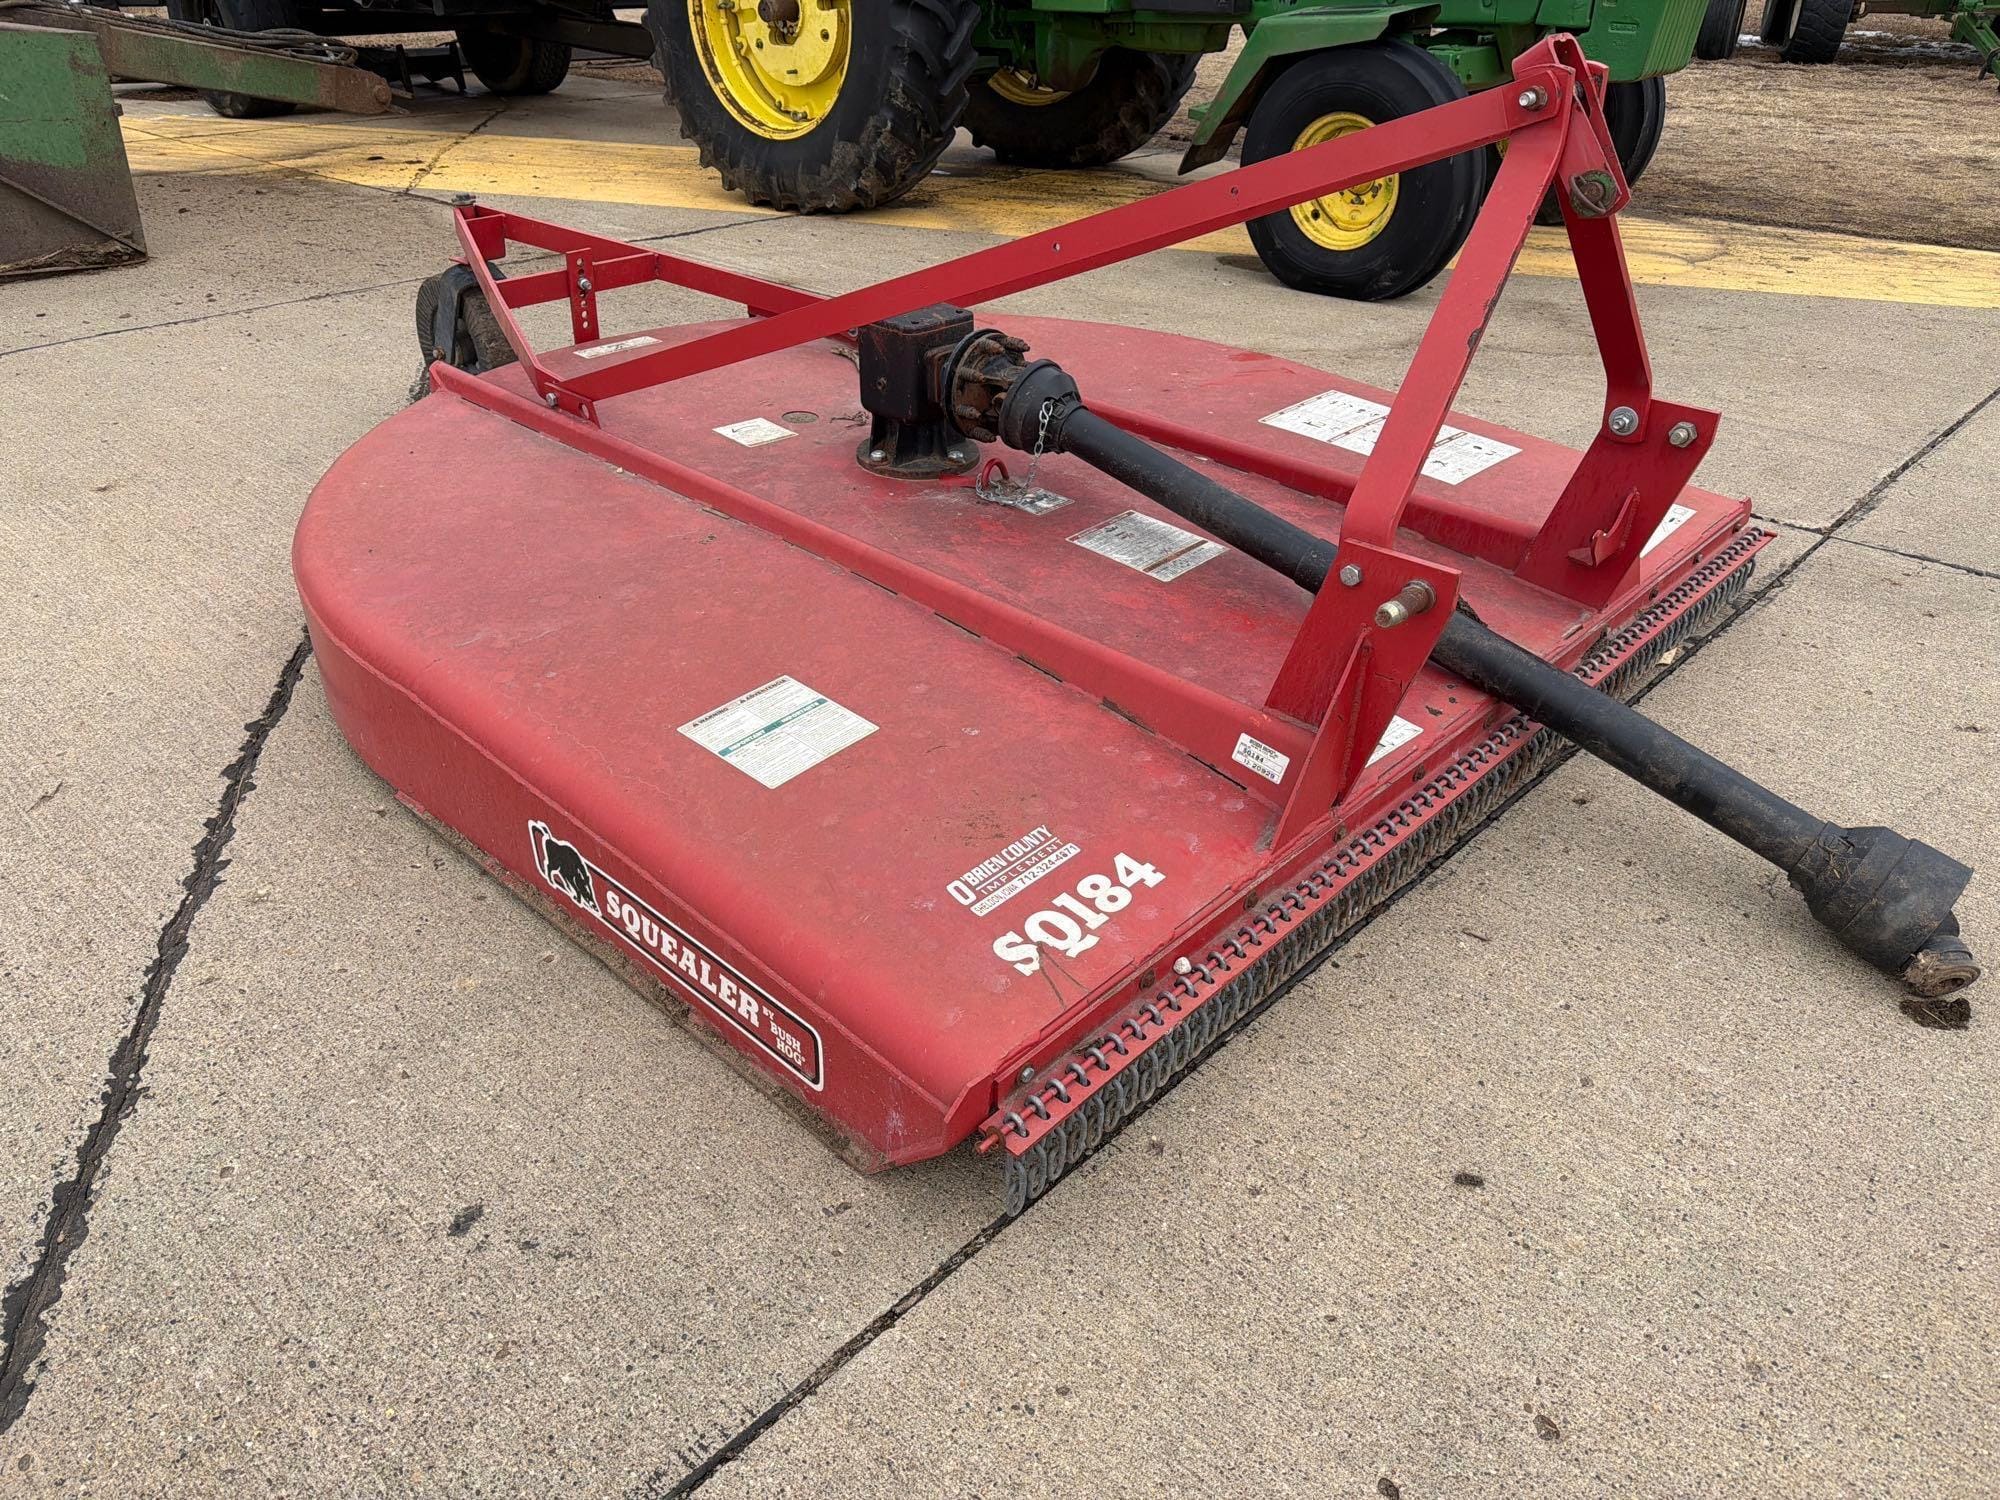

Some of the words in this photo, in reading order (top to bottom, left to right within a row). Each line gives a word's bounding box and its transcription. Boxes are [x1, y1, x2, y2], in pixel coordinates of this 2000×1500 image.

[698, 707, 729, 725] WARNING
[729, 729, 766, 752] IMPORTANT
[946, 854, 1009, 906] O'BRIEN
[1005, 824, 1053, 863] COUNTY
[980, 839, 1065, 895] IMPLEMENT
[992, 852, 1166, 976] SQ184
[606, 889, 760, 1028] SQUEALER
[763, 1005, 775, 1019] BY
[770, 1020, 802, 1053] BUSH
